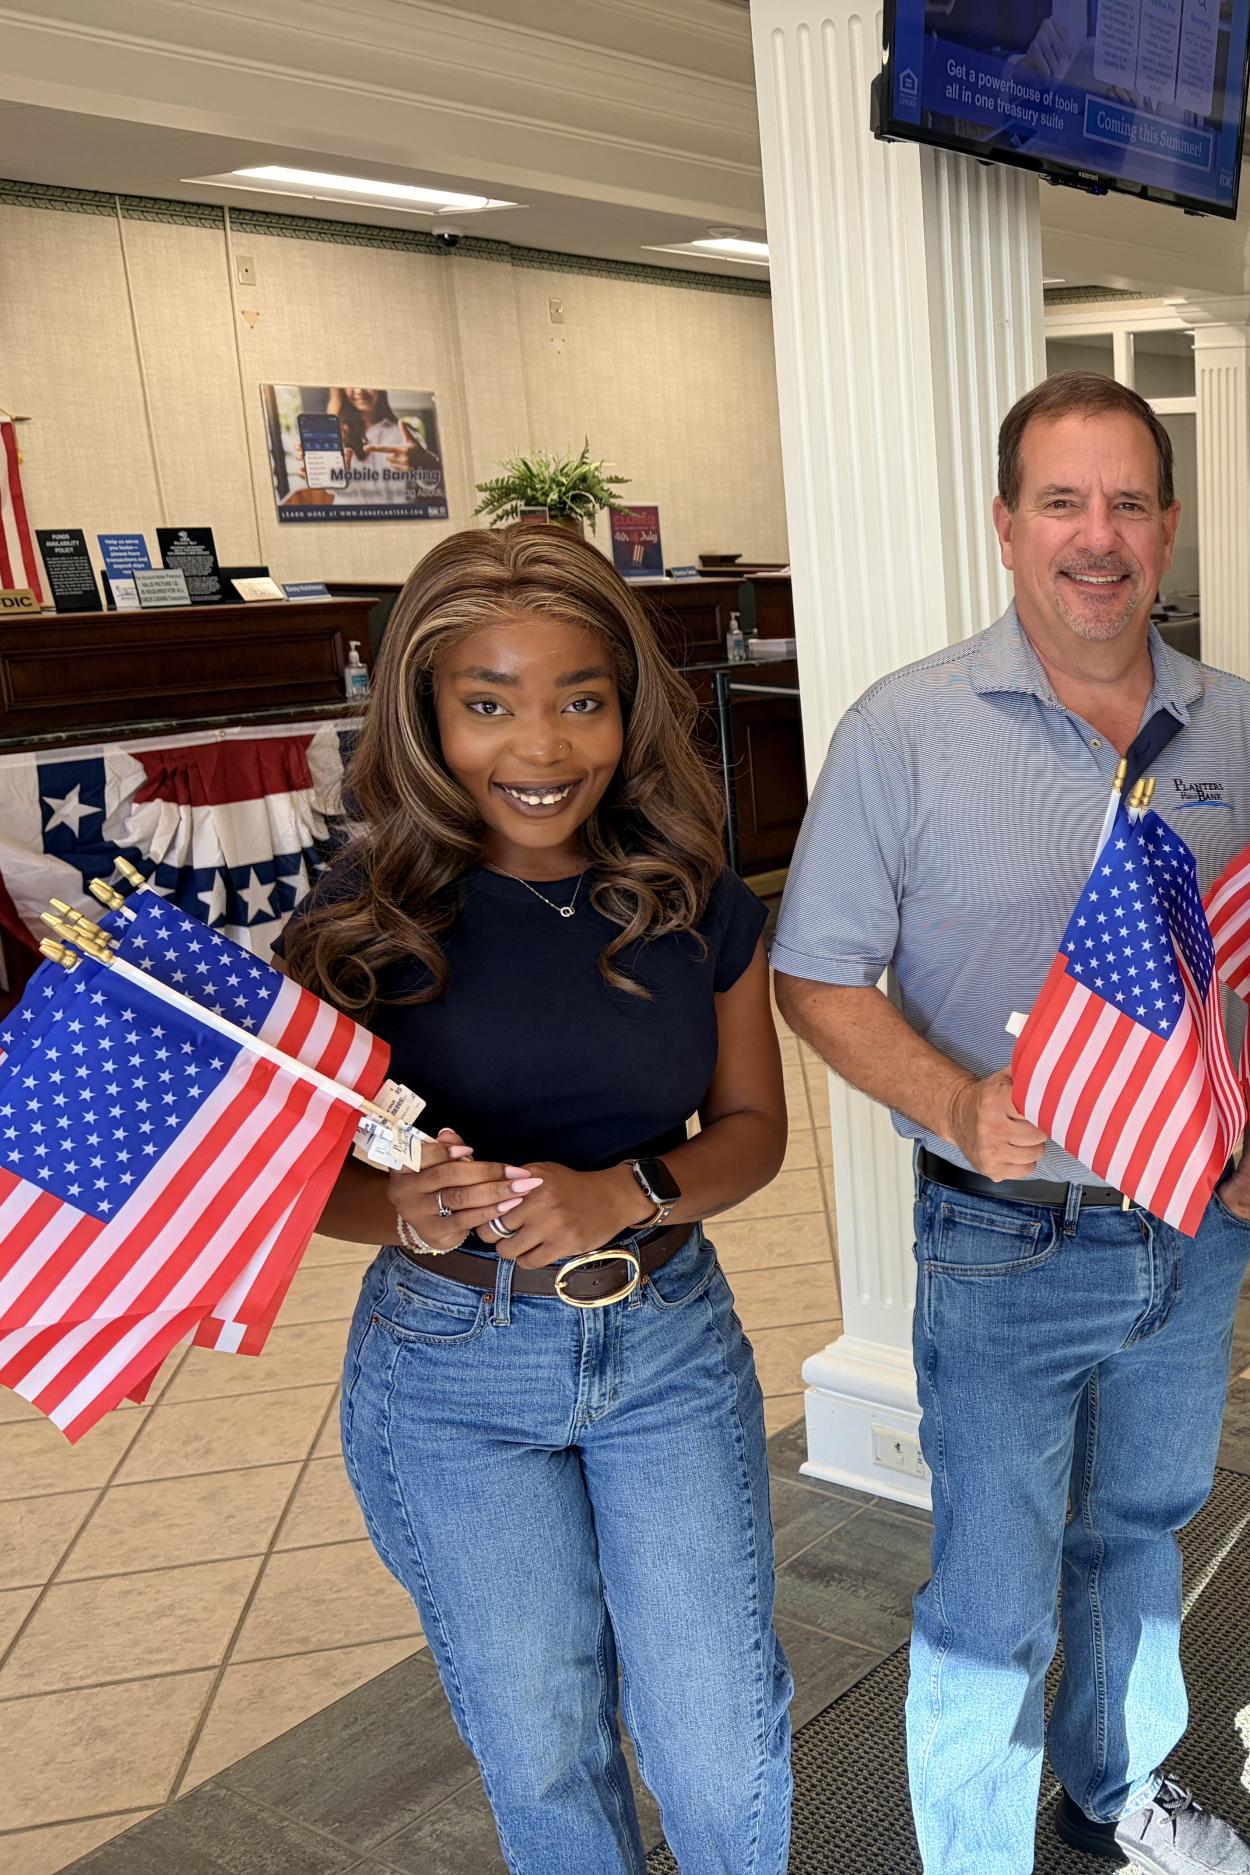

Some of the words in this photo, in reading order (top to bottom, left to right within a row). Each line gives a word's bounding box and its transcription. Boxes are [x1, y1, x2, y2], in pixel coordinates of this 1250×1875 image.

[947, 59, 967, 80] Get
[968, 70, 976, 82] a
[978, 72, 1041, 103] powerhouse
[1043, 92, 1053, 107] of
[1055, 95, 1079, 115] tools
[945, 83, 960, 100] all
[961, 86, 972, 103] in
[974, 94, 995, 110] one
[997, 97, 1039, 127] treasury
[1040, 112, 1064, 130] suite
[1097, 110, 1137, 142] Coming
[1139, 122, 1160, 145] this
[1160, 130, 1203, 158] Summer!
[330, 467, 380, 481] Mobile
[382, 467, 441, 485] Banking
[281, 510, 305, 518] LEARN
[328, 509, 337, 517] AT
[614, 531, 629, 542] 4th
[640, 531, 658, 544] July
[0, 596, 33, 608] DIC
[1173, 778, 1224, 791] PLANTERS
[1197, 789, 1222, 802] BANK
